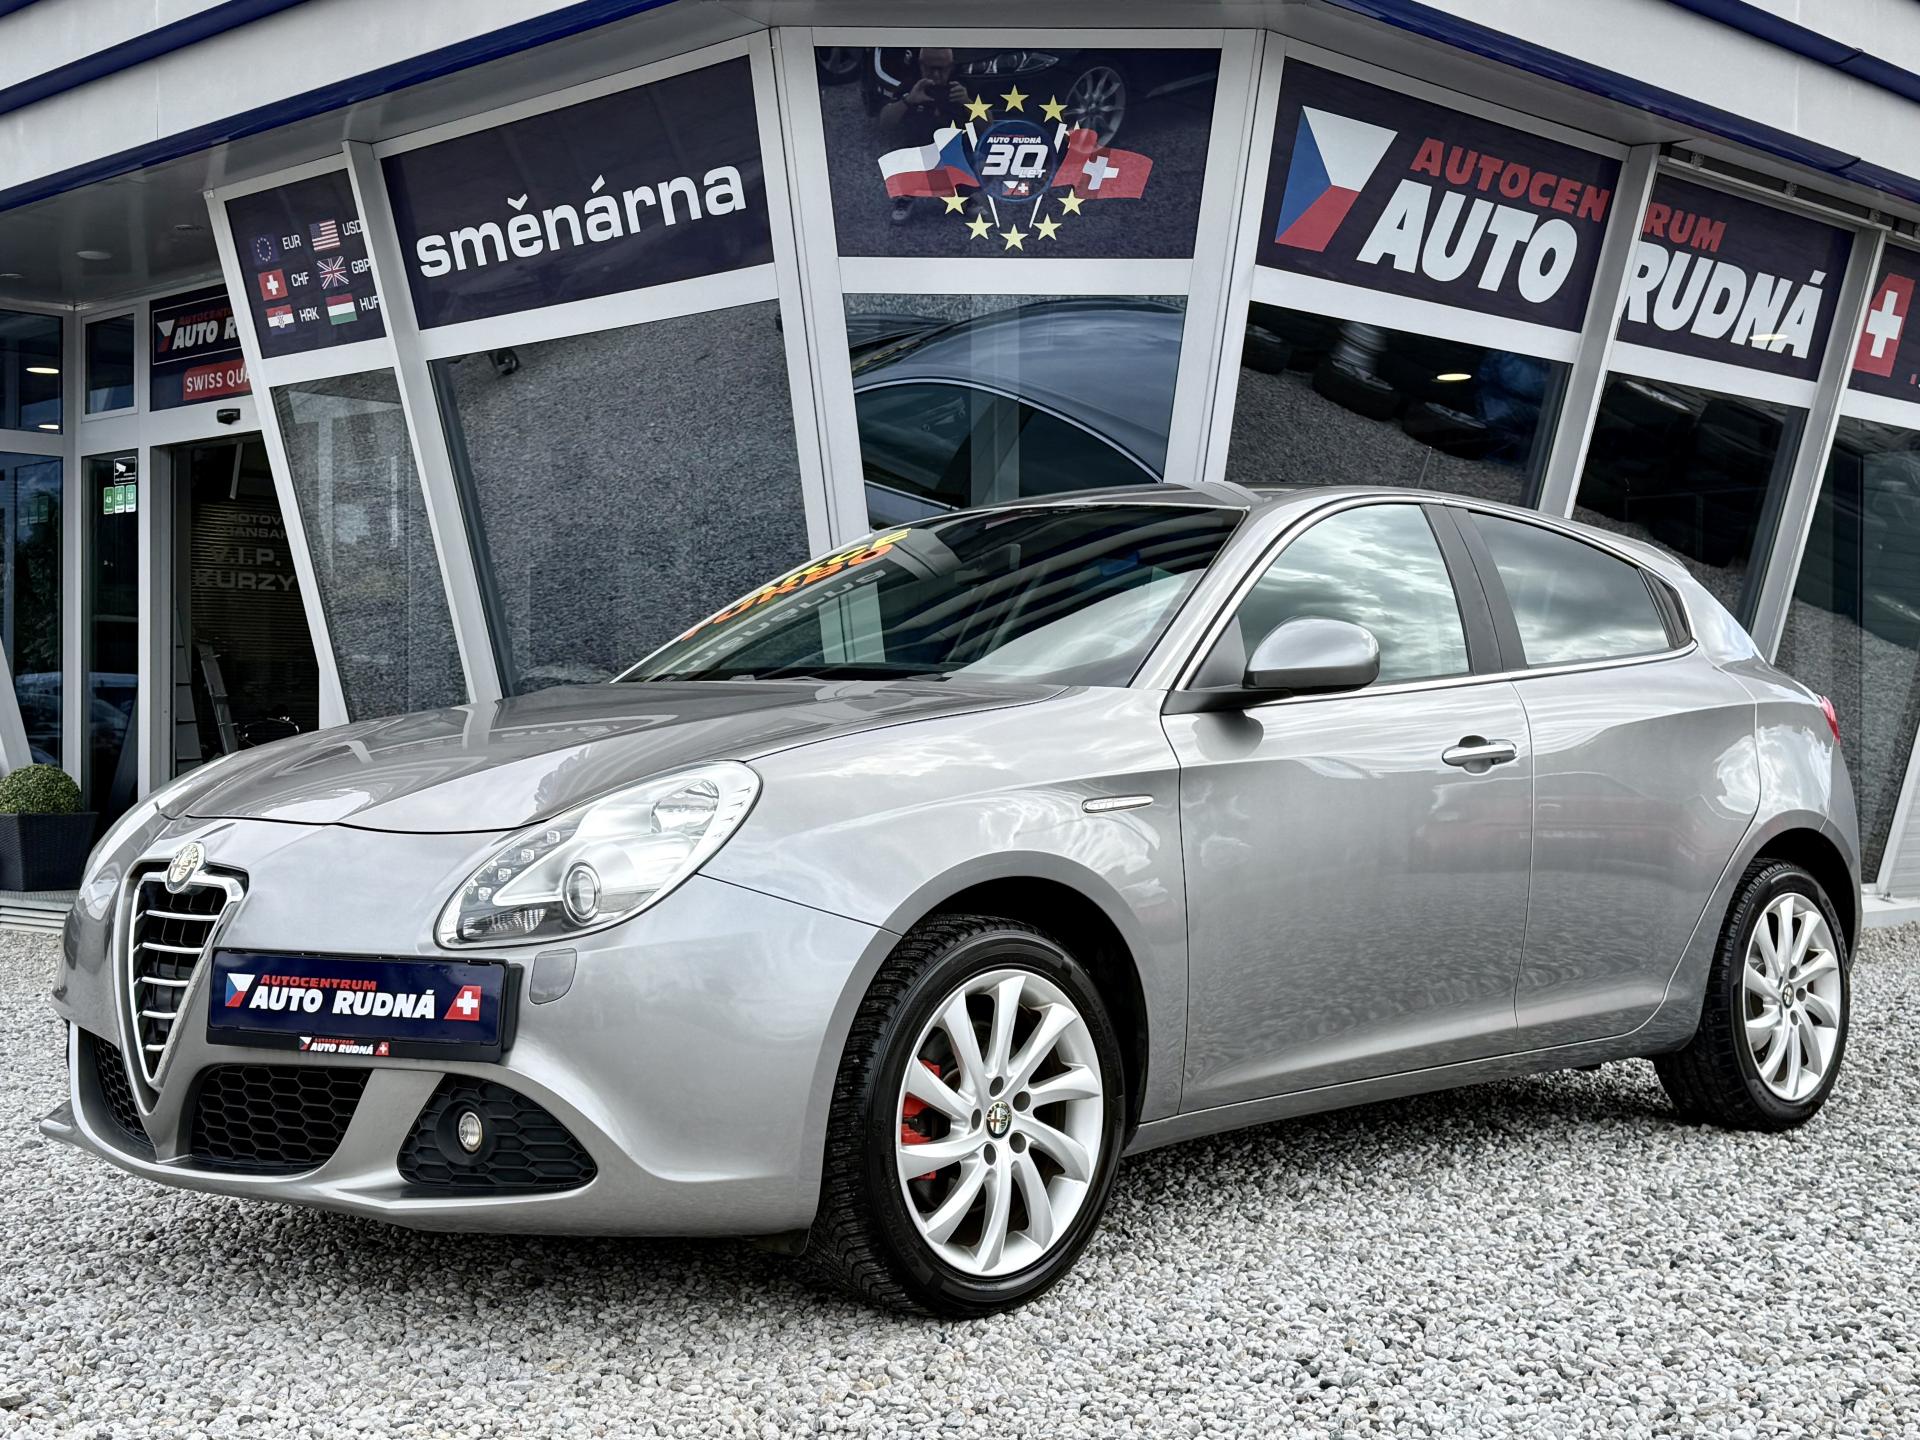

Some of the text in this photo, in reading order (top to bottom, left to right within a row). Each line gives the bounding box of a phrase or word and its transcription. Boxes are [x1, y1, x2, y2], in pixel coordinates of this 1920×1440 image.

[987, 136, 1010, 144] AUTO
[1012, 135, 1042, 144] RUDNÁ
[981, 144, 1049, 176] 30
[342, 220, 362, 236] USD
[416, 165, 747, 278] směnárna
[282, 234, 302, 250] EUR
[351, 258, 371, 274] GBP
[1356, 178, 1828, 359] AUTO RUDNÁ
[291, 271, 310, 287] CHF
[359, 295, 379, 312] HUF
[299, 306, 320, 322] HRK
[172, 320, 219, 350] AUTO
[186, 371, 223, 393] SWISS
[194, 569, 296, 592] KURZY
[260, 974, 377, 991] AUTOCENTRUM
[249, 985, 435, 1019] AUTO RUDNÁ
[310, 1043, 374, 1055] AUTO RUDNÁ
